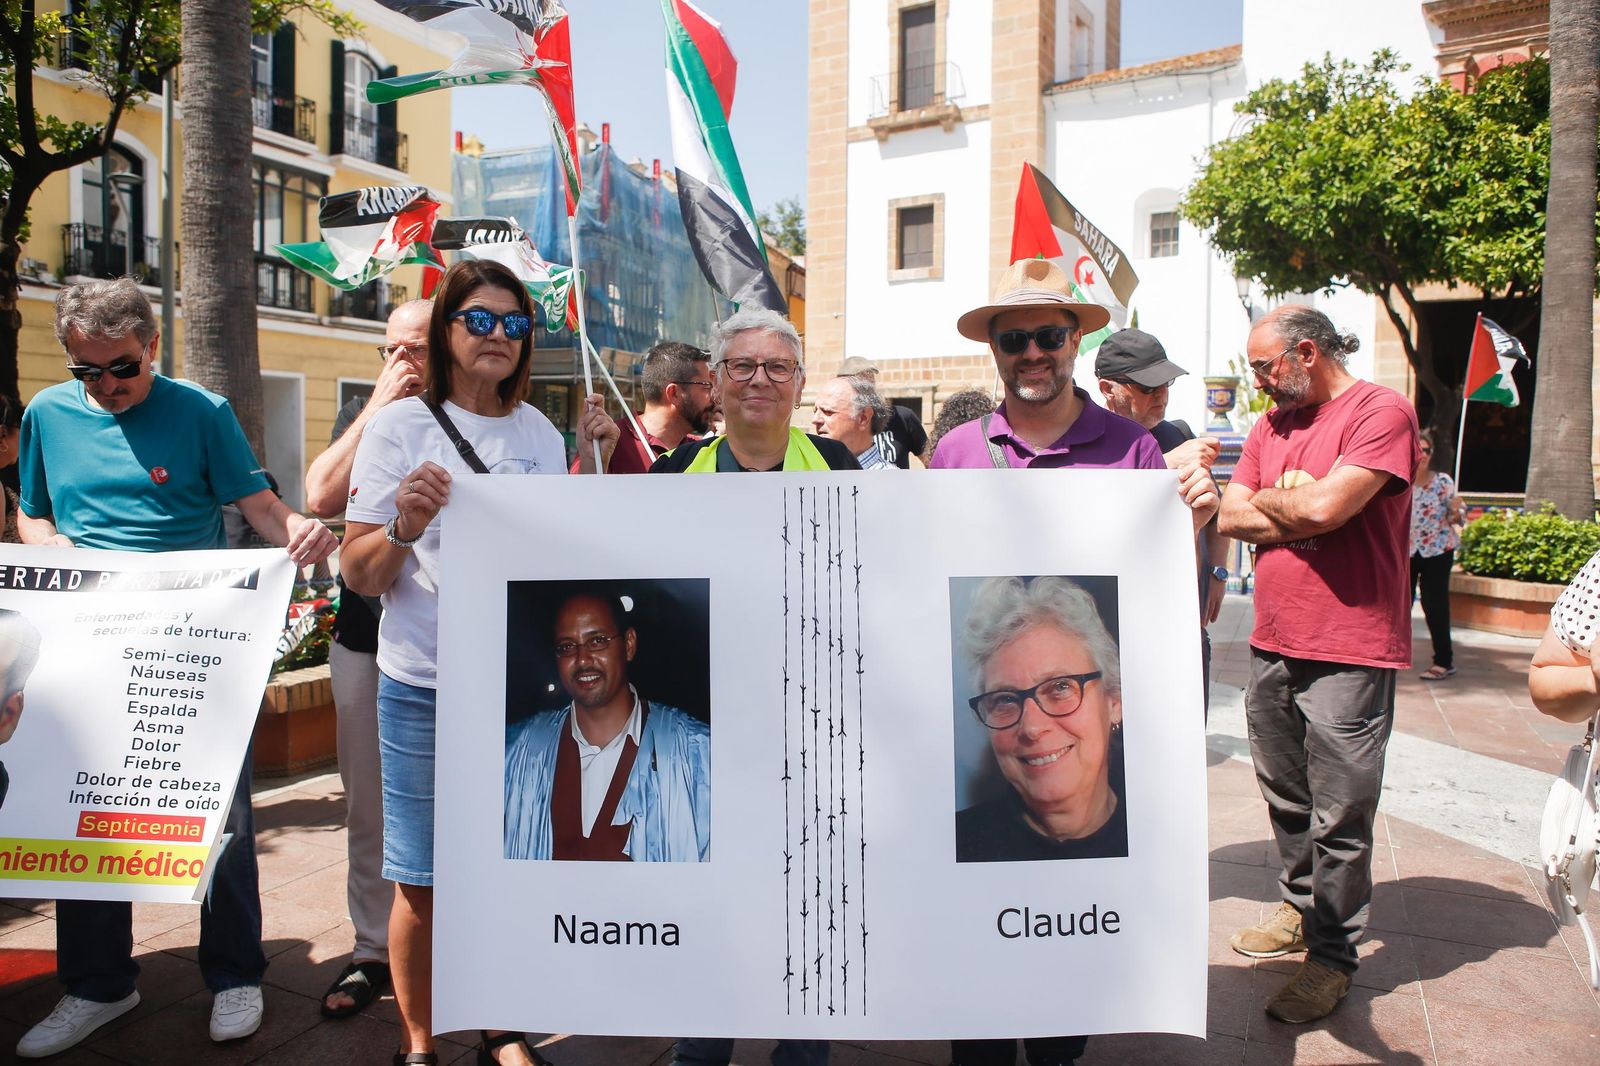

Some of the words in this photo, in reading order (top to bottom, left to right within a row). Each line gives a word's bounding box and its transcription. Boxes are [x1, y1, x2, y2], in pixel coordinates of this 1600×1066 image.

[1074, 211, 1120, 278] SAHARA
[0, 566, 82, 590] ERTAD
[97, 571, 161, 589] PRA
[74, 610, 180, 623] Enfermedas
[184, 611, 193, 623] y
[164, 624, 183, 636] de
[188, 625, 252, 642] tortura:
[122, 647, 222, 668] Semi-ciego
[130, 664, 207, 682] Náuseas
[126, 682, 205, 700] Enuresis
[127, 700, 198, 718] Espalda
[133, 719, 185, 735] Asma
[131, 737, 182, 753] Dolor
[123, 755, 182, 771] Fiebre
[76, 771, 126, 787] Dolor
[131, 775, 153, 788] de
[159, 777, 221, 792] cabeza
[68, 790, 150, 807] Infección
[157, 795, 179, 809] de
[185, 795, 220, 811] oído
[80, 815, 201, 837] Septicemia
[97, 849, 205, 879] médico
[553, 913, 681, 946] Naama
[996, 903, 1121, 939] Claude
